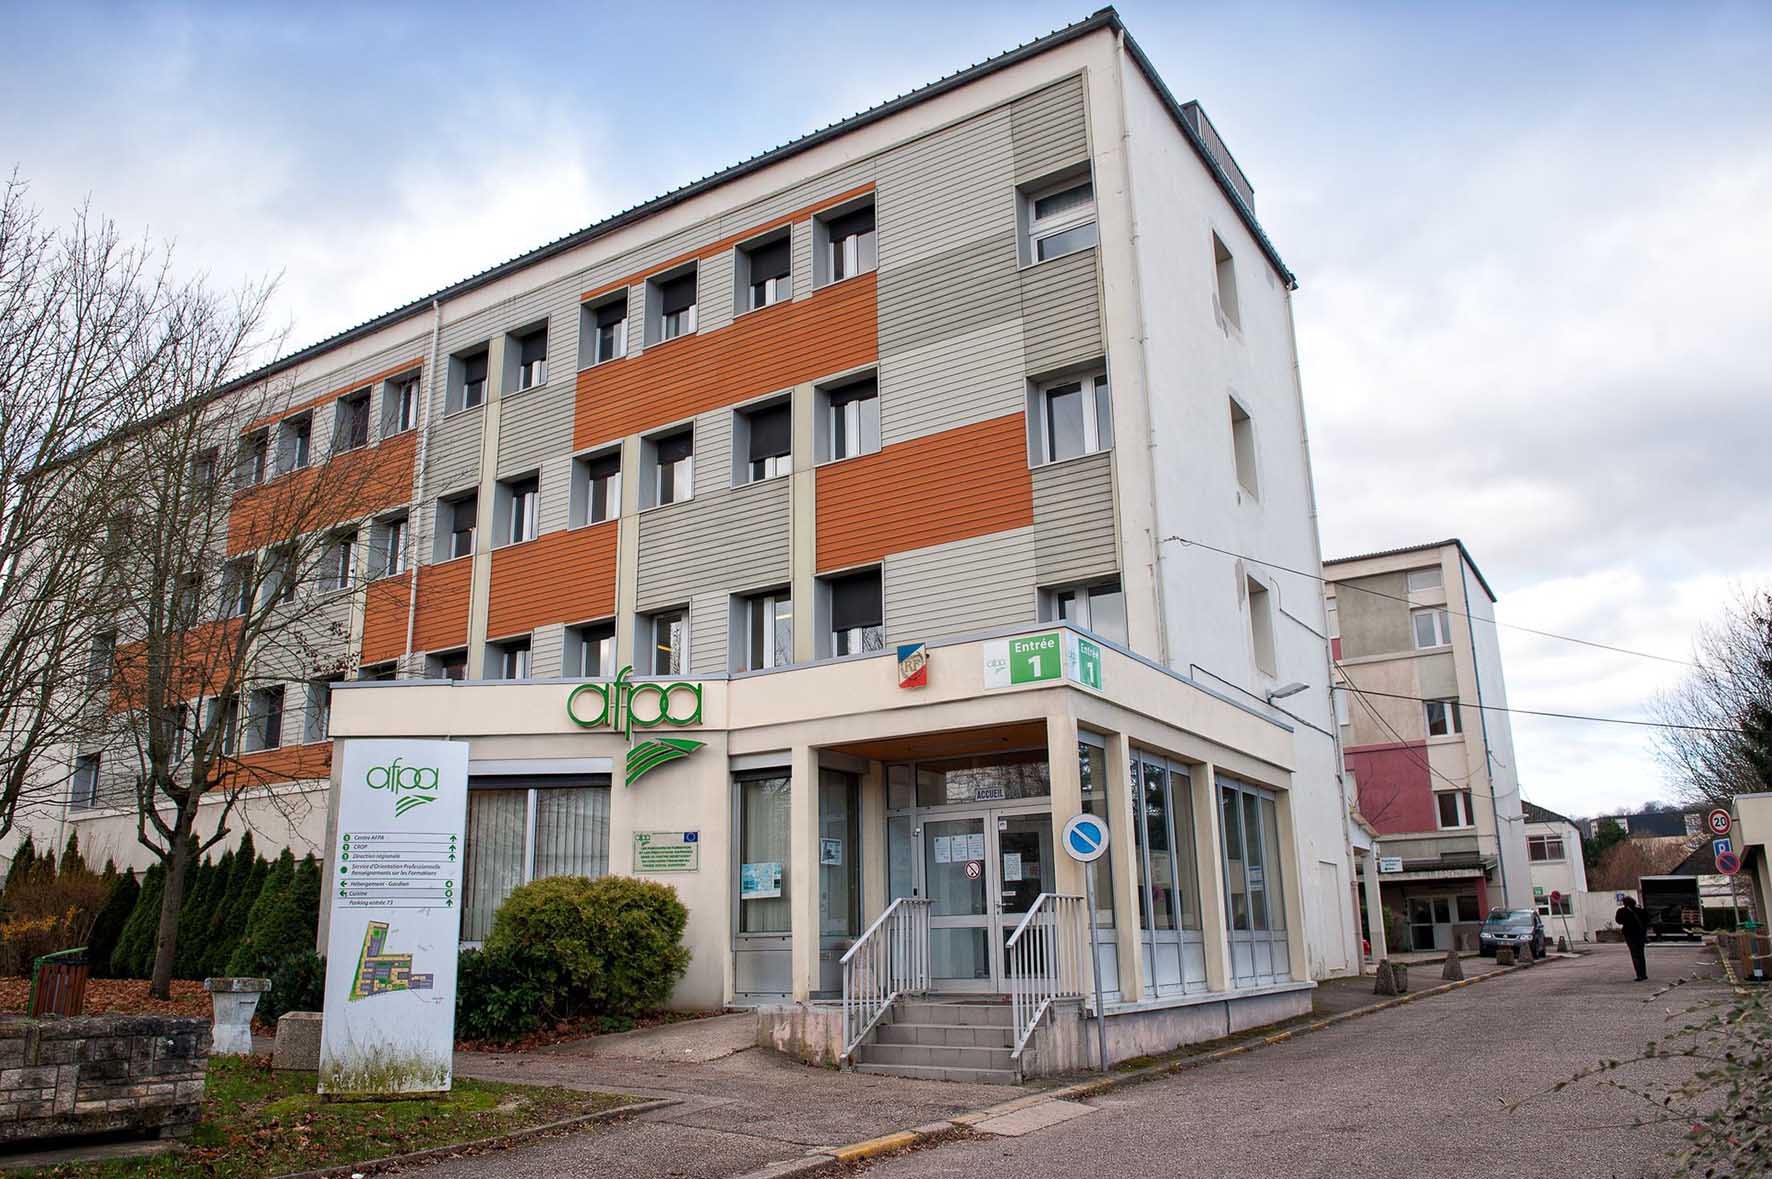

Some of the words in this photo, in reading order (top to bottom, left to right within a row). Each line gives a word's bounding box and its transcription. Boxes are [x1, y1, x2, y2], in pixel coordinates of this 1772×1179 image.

[1015, 638, 1055, 653] Entrée
[1027, 655, 1041, 677] 1
[1087, 662, 1094, 684] 1
[567, 665, 703, 741] afpa
[366, 757, 439, 795] afpa
[977, 789, 1003, 799] ACCUEIL
[1714, 817, 1726, 826] 20
[1718, 843, 1726, 854] P
